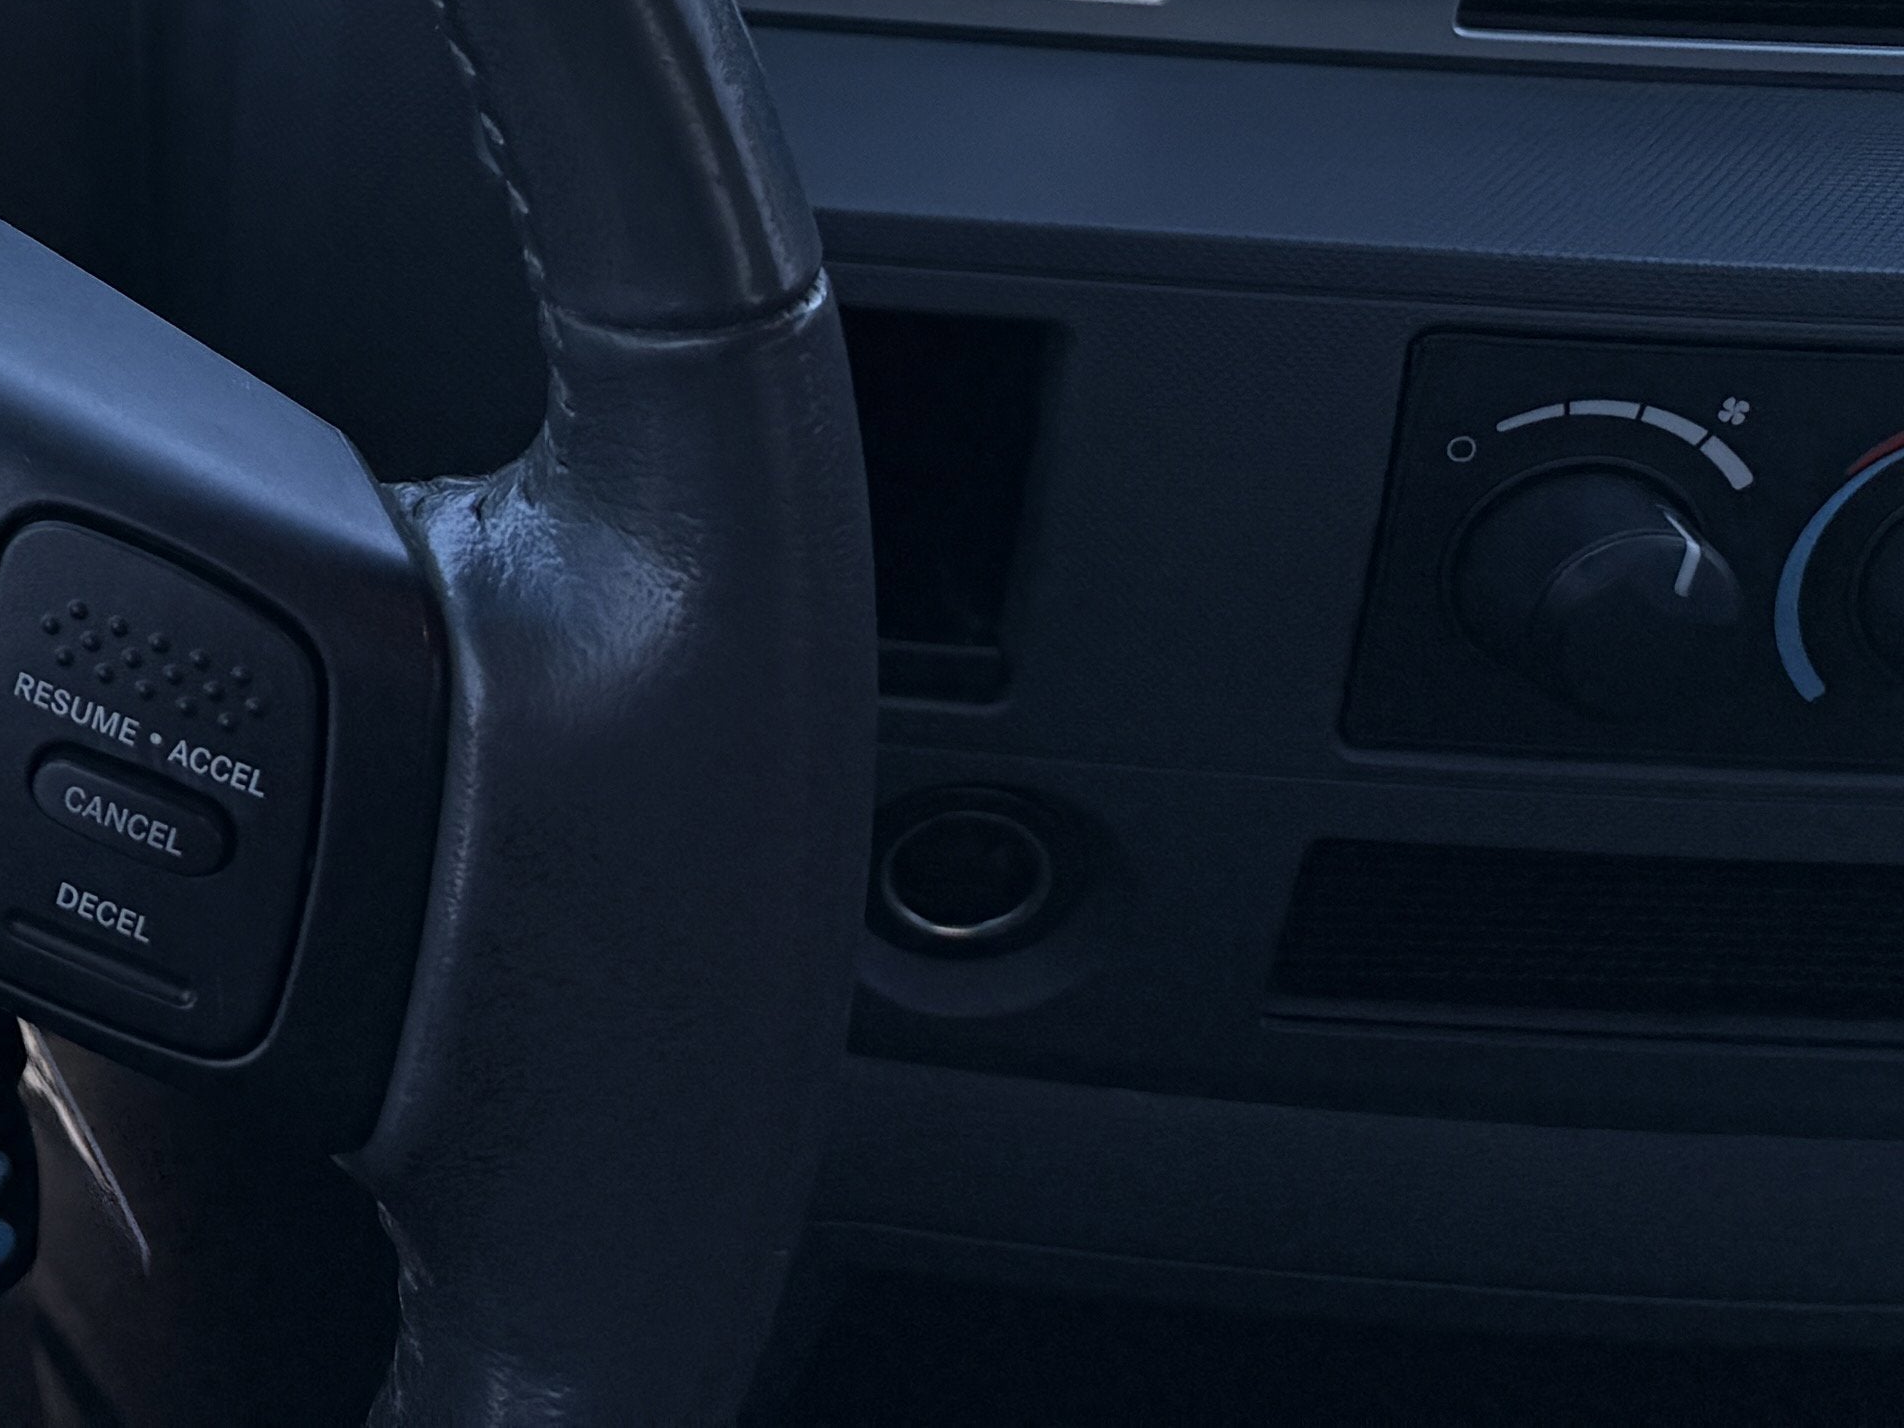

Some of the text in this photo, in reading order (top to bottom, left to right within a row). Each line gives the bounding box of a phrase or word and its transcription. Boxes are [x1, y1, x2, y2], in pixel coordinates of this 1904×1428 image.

[14, 672, 266, 799] RESUME ACCEL
[63, 786, 184, 857] CANCEL
[56, 882, 150, 944] DECEL
